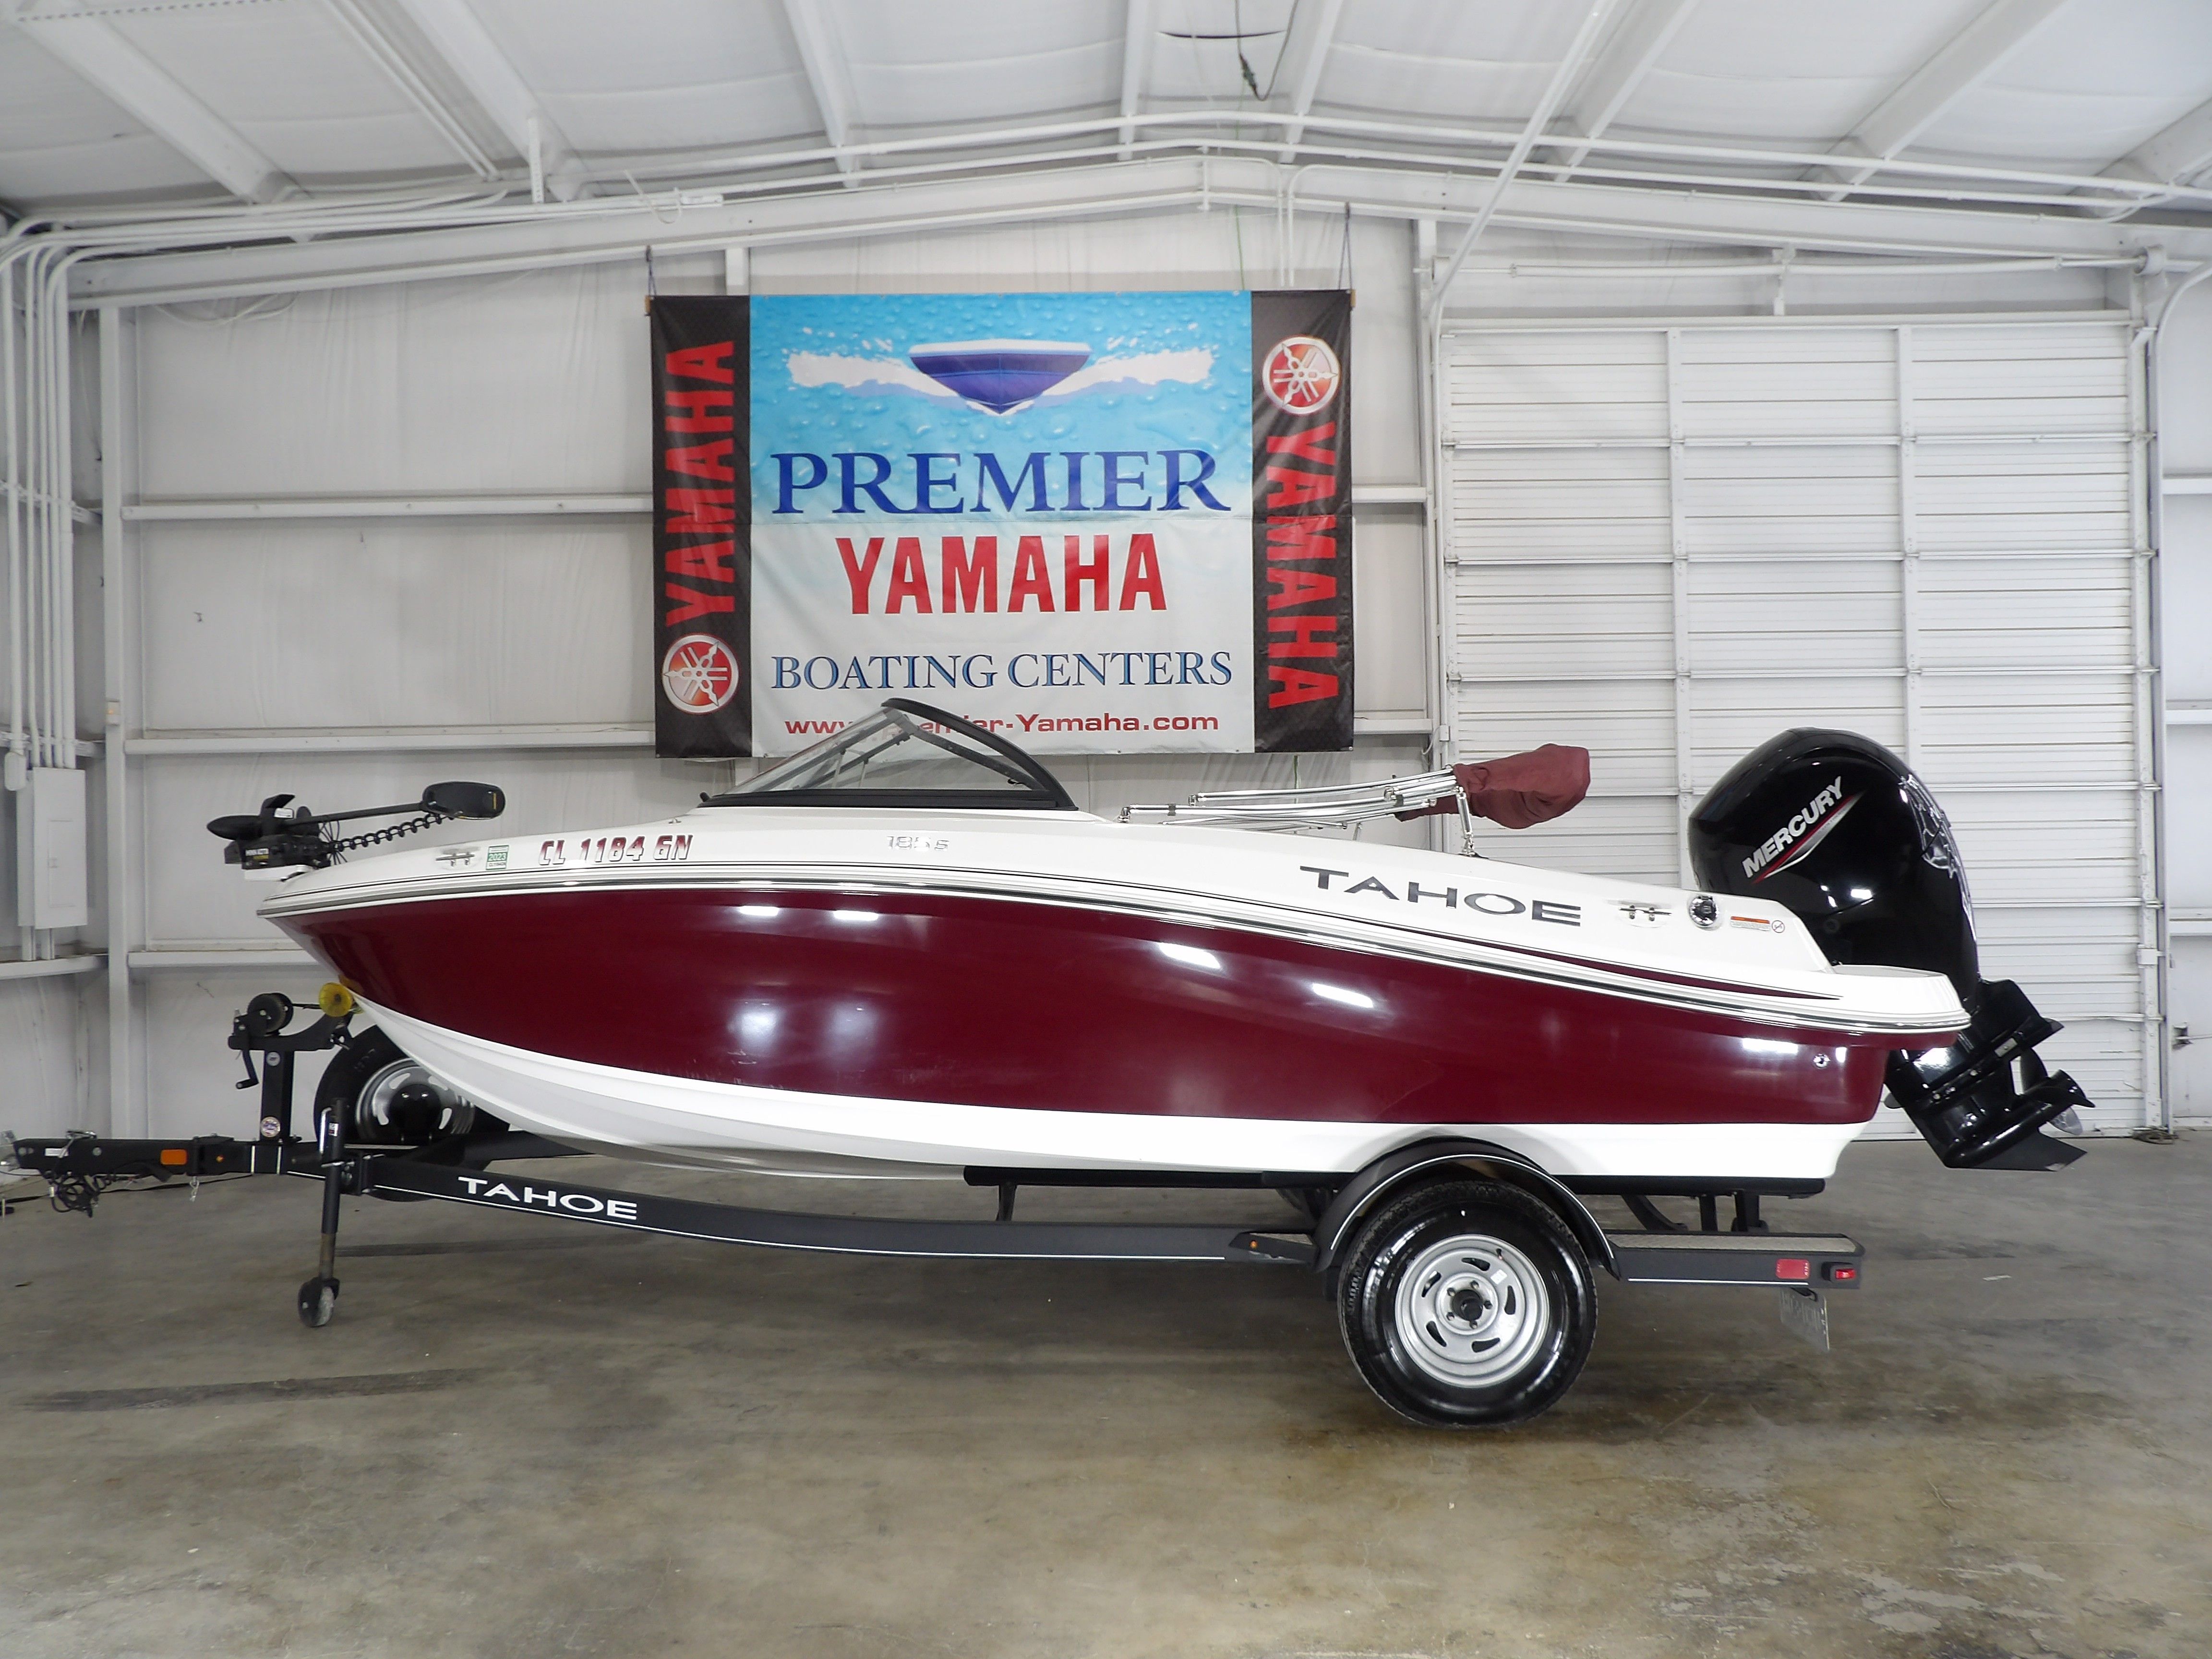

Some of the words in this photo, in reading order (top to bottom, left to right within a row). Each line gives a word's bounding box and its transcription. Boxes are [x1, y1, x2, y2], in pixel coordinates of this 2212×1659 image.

[664, 340, 735, 627] YAMAHA
[770, 449, 1231, 515] PREMIER
[835, 533, 1167, 614] YAMAHA
[1266, 421, 1339, 709] YAMAHA
[771, 654, 998, 690] BOATING
[1008, 651, 1232, 688] CENTERS
[488, 853, 507, 861] 2023
[539, 840, 566, 866] CL
[580, 836, 646, 863] 1184
[1742, 776, 1843, 878] MERCURY
[1299, 866, 1581, 927] TAHOE
[457, 1176, 637, 1220] TAHOE
